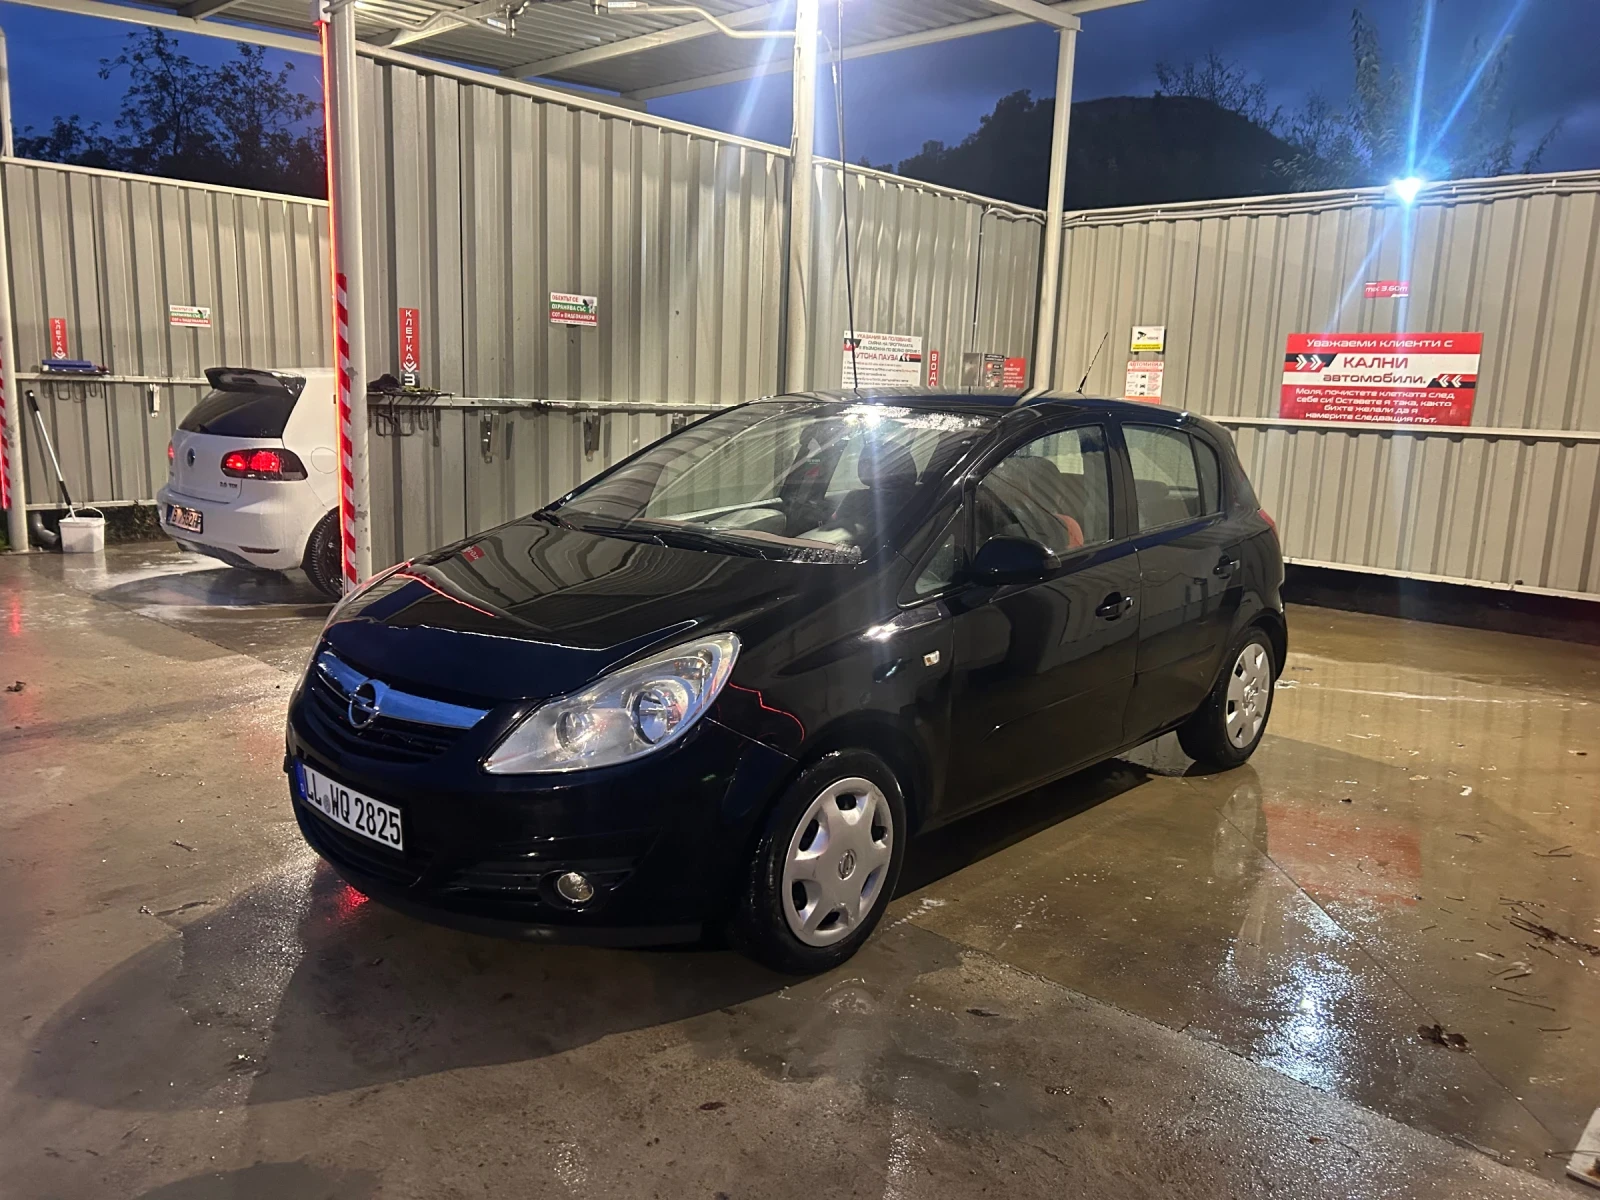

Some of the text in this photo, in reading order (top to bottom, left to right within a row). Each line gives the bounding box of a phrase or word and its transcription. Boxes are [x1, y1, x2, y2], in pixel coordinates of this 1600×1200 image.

[1307, 339, 1376, 347] Уважаеми
[1344, 357, 1408, 368] КАЛНИ
[1323, 372, 1426, 384] автомобили.
[304, 768, 400, 844] LL HQ 2825
